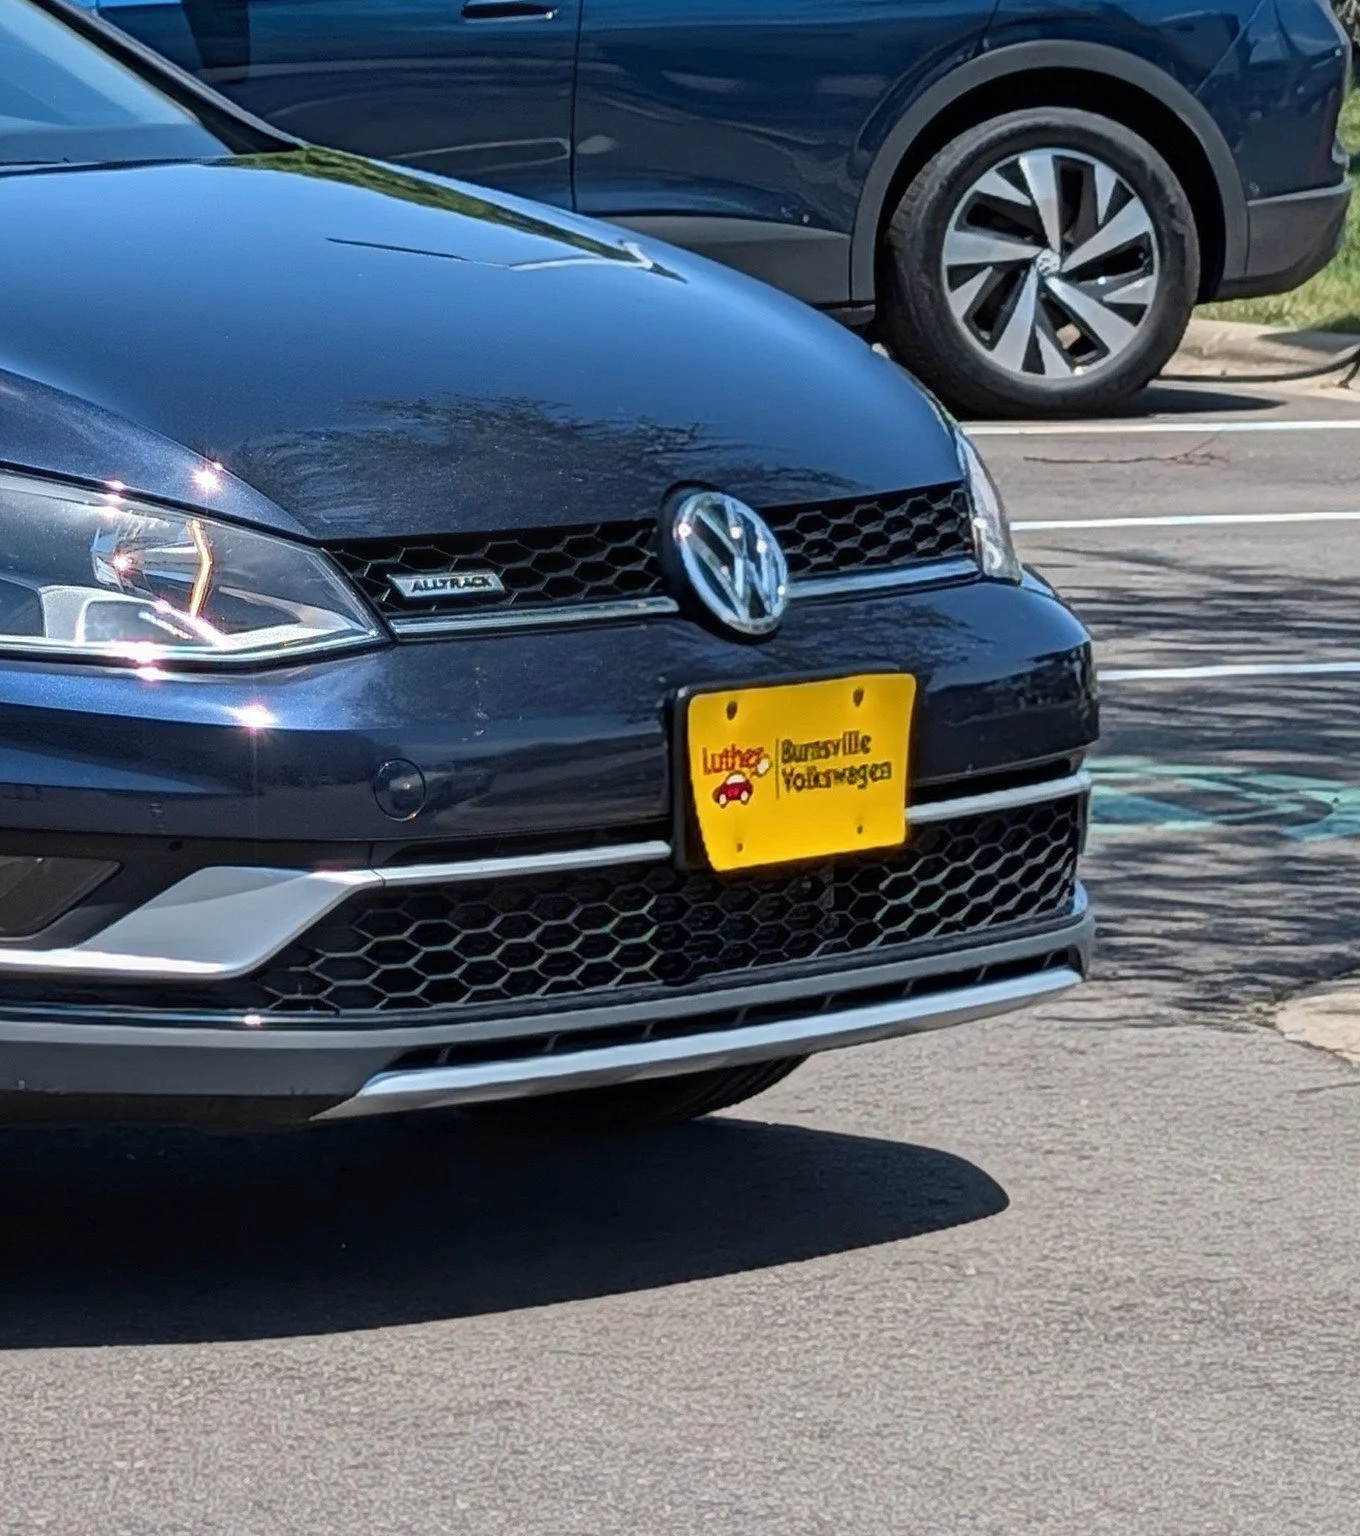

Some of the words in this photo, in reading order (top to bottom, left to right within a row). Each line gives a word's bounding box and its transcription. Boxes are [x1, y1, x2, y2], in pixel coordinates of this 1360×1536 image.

[411, 576, 493, 593] ALLTRACK
[780, 730, 872, 764] Burnsville
[781, 761, 892, 793] Volkswagen
